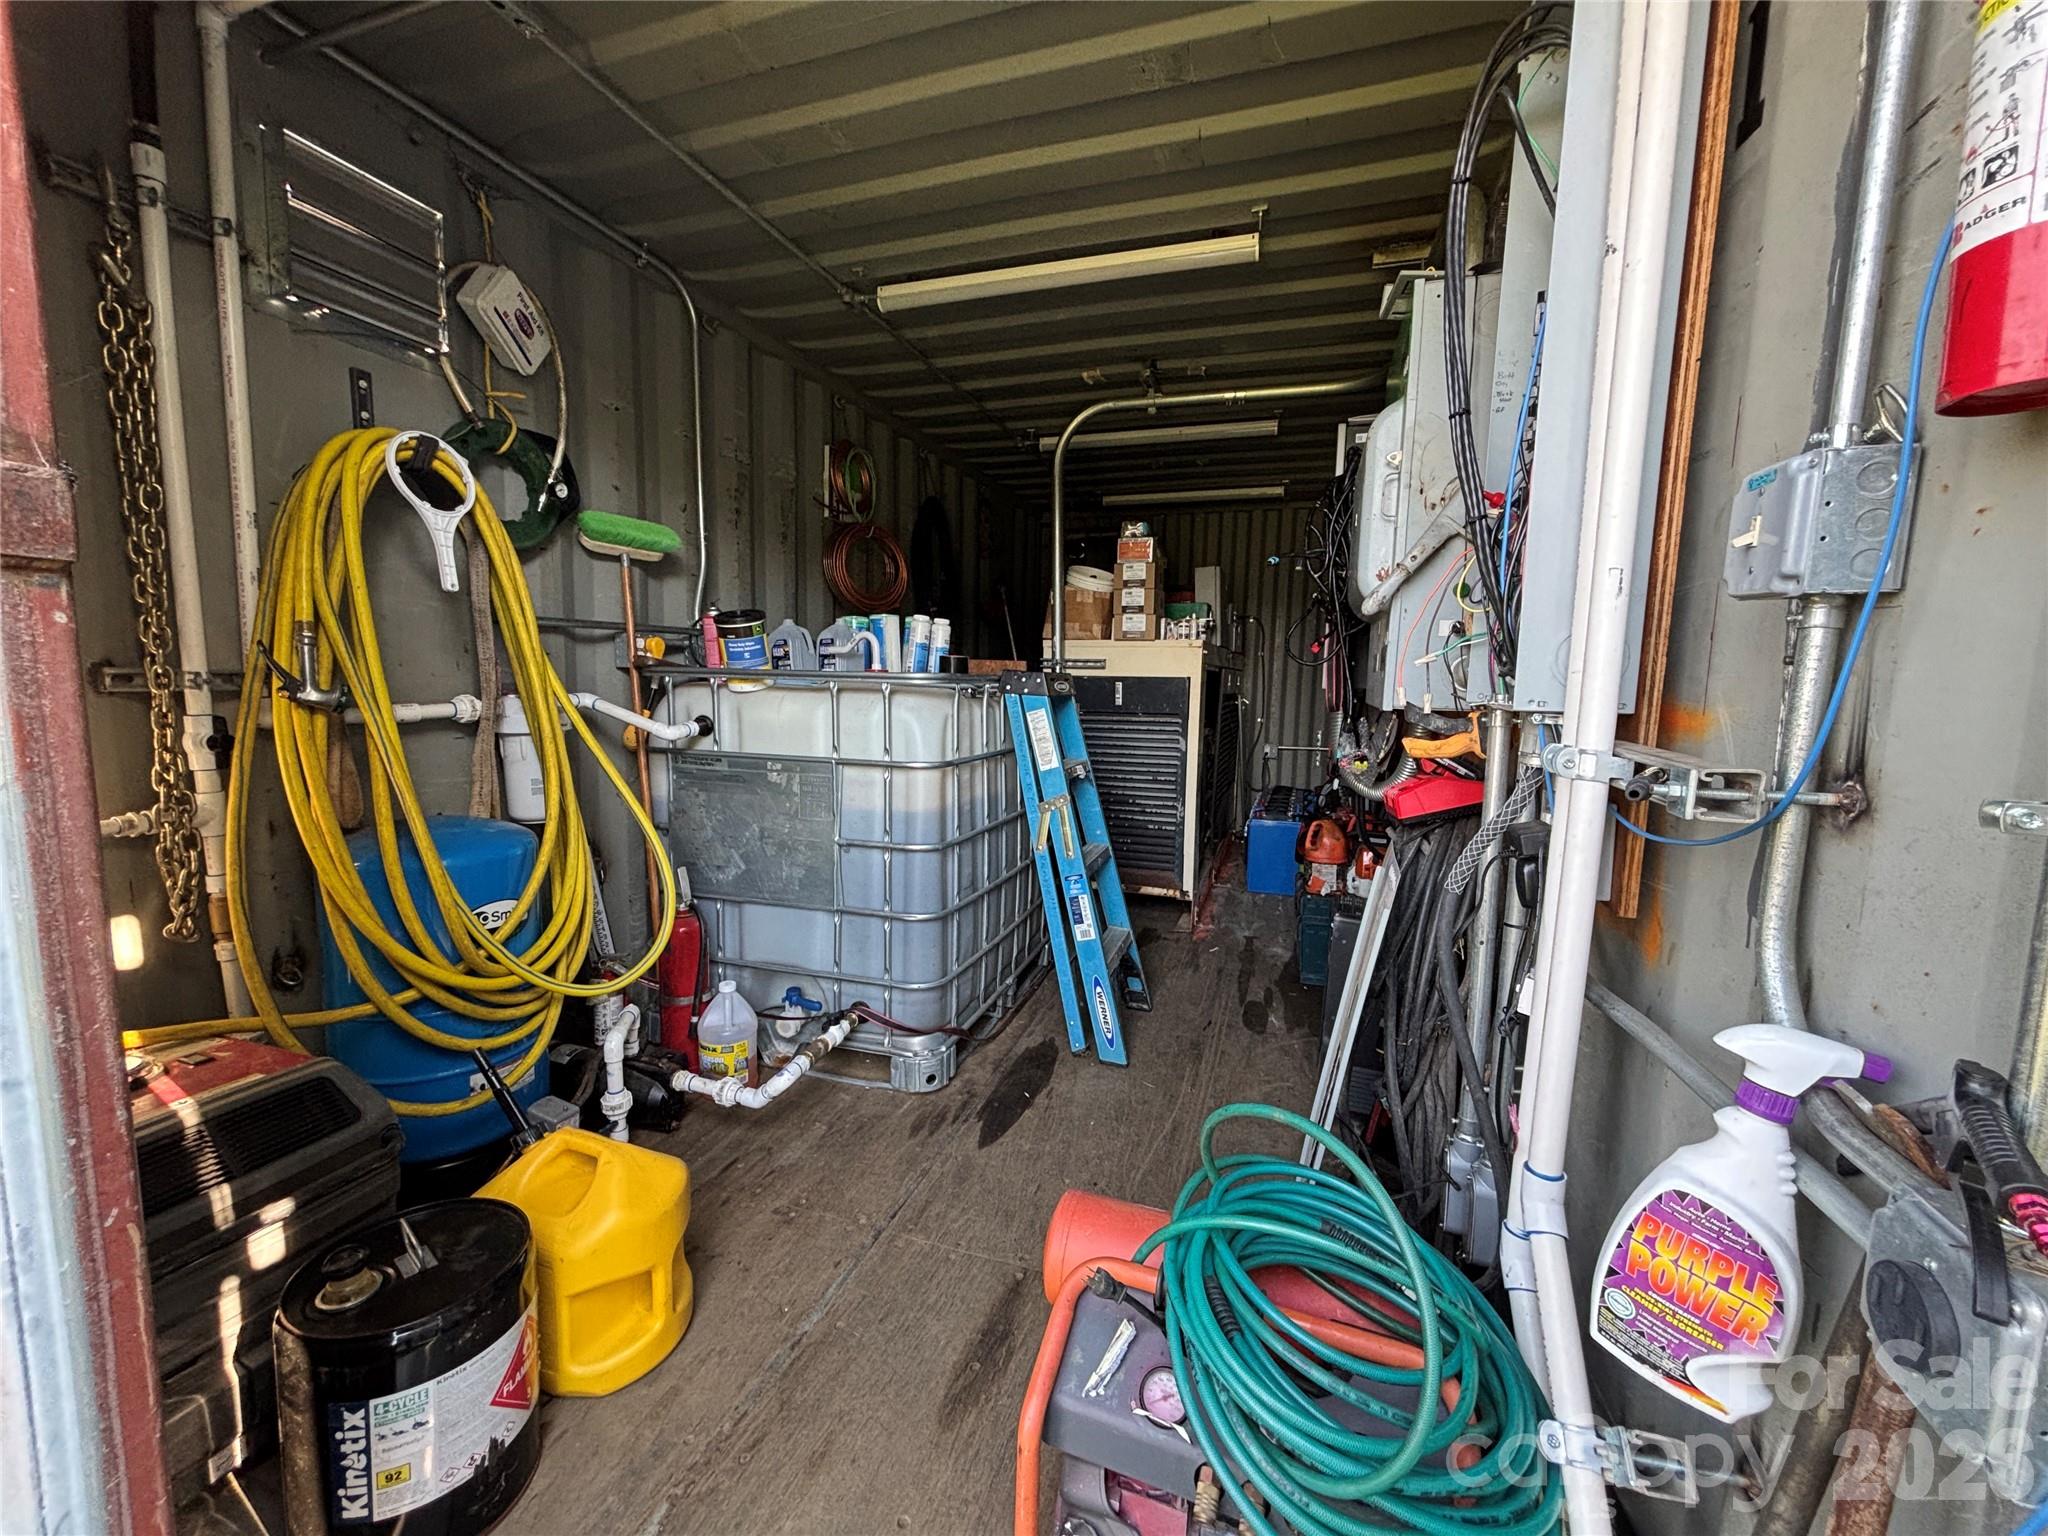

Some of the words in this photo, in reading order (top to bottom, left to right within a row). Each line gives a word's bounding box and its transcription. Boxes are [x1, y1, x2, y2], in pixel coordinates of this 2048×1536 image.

[1097, 990, 1112, 1036] WERNER
[1669, 1202, 1696, 1221] Industry
[1701, 1219, 1719, 1232] Farm
[1723, 1230, 1749, 1246] Marine
[1688, 1207, 1707, 1219] Auto
[1710, 1217, 1731, 1231] Home
[1632, 1211, 1778, 1317] PURPLE
[1626, 1239, 1769, 1348] POWER
[1675, 1312, 1714, 1338] STRENGTH
[375, 1388, 429, 1415] 4-CYCLE
[335, 1408, 369, 1519] Kinetix
[384, 1470, 403, 1485] 92
